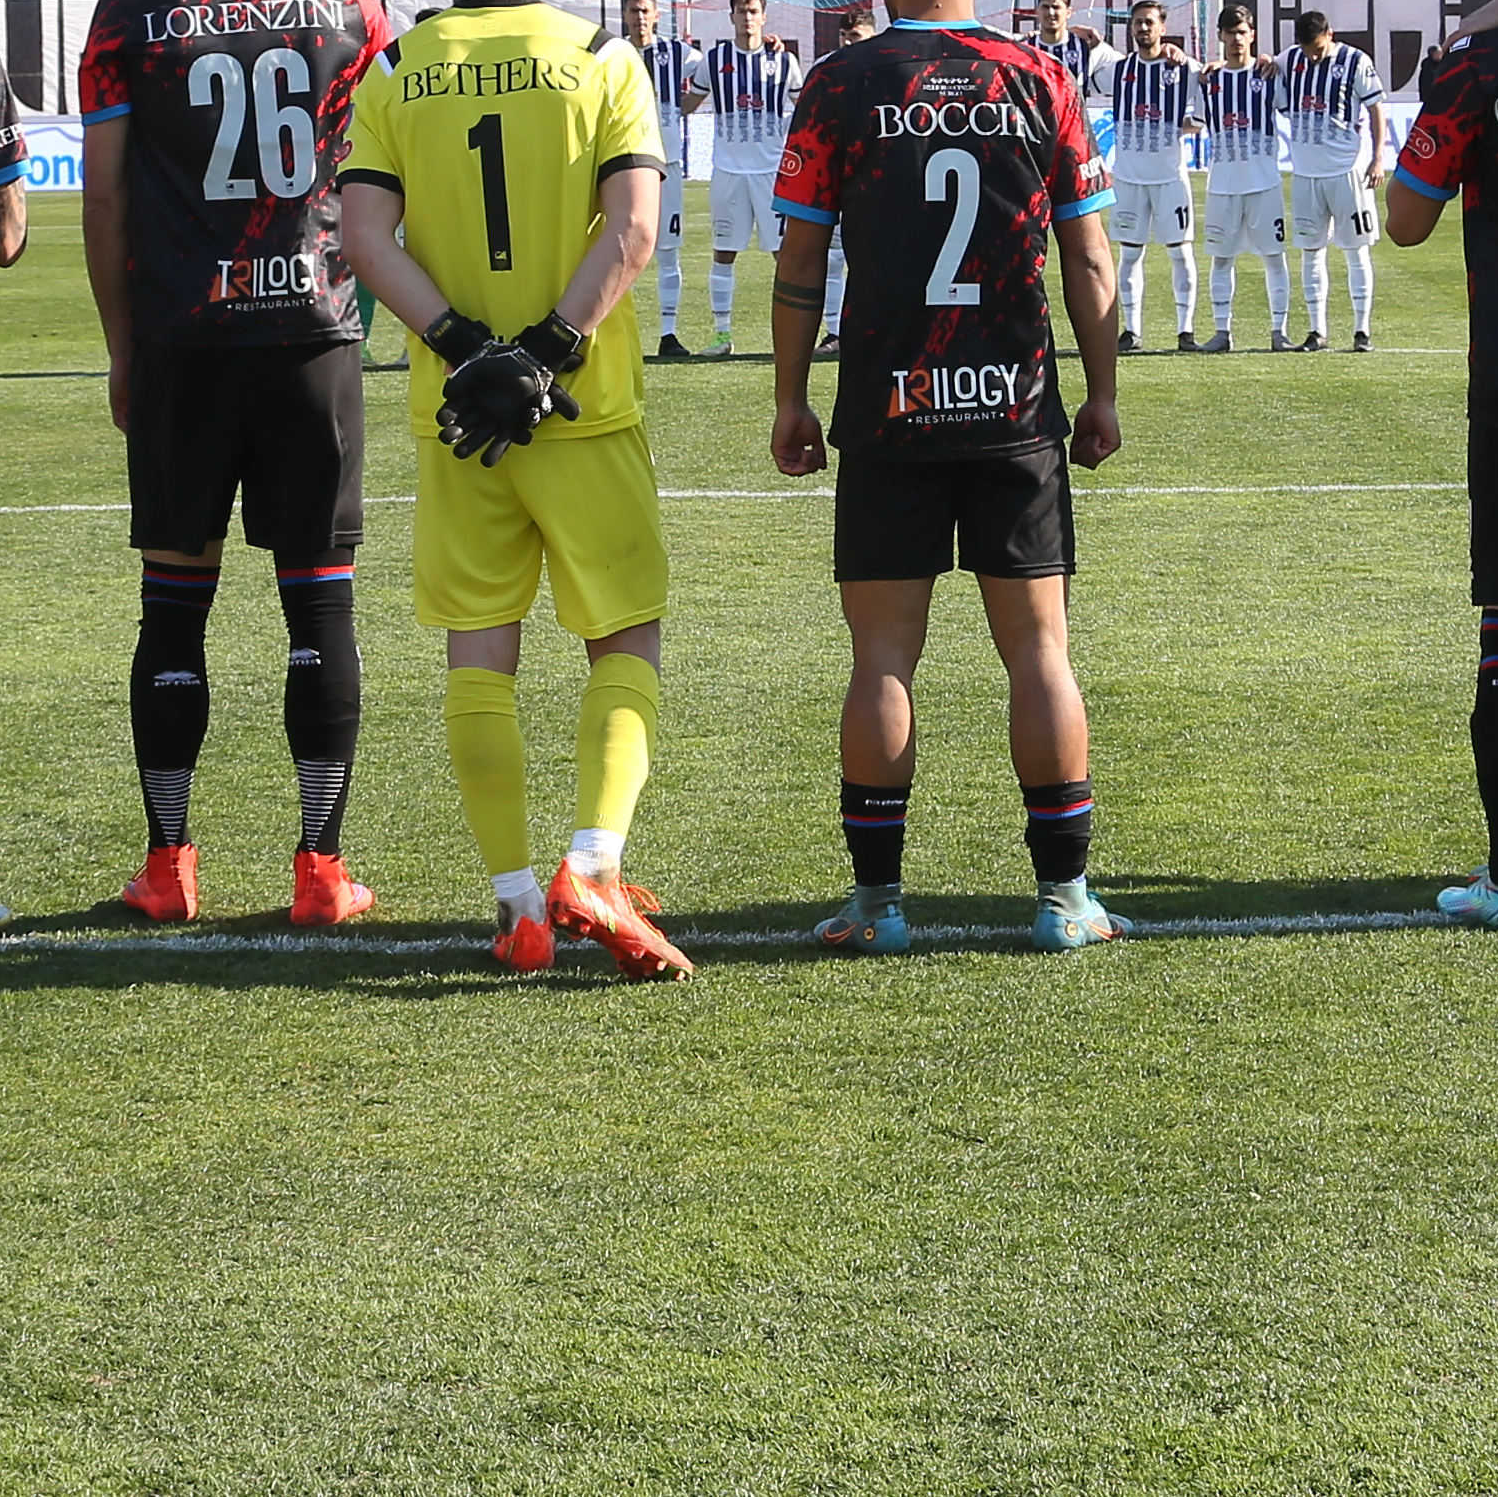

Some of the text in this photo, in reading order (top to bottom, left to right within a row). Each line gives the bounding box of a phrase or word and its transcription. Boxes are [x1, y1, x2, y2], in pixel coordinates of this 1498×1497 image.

[402, 57, 580, 104] BETHERS
[188, 48, 317, 200] 26
[875, 101, 1042, 145] BOCCIA
[467, 113, 513, 271] 1
[668, 213, 681, 237] 4
[924, 148, 981, 306] 2
[1273, 218, 1286, 243] 3
[1351, 210, 1374, 236] 10
[235, 298, 306, 311] RESTAURANT
[891, 363, 1020, 412] TRILOGY
[915, 411, 997, 424] RESTAURANT
